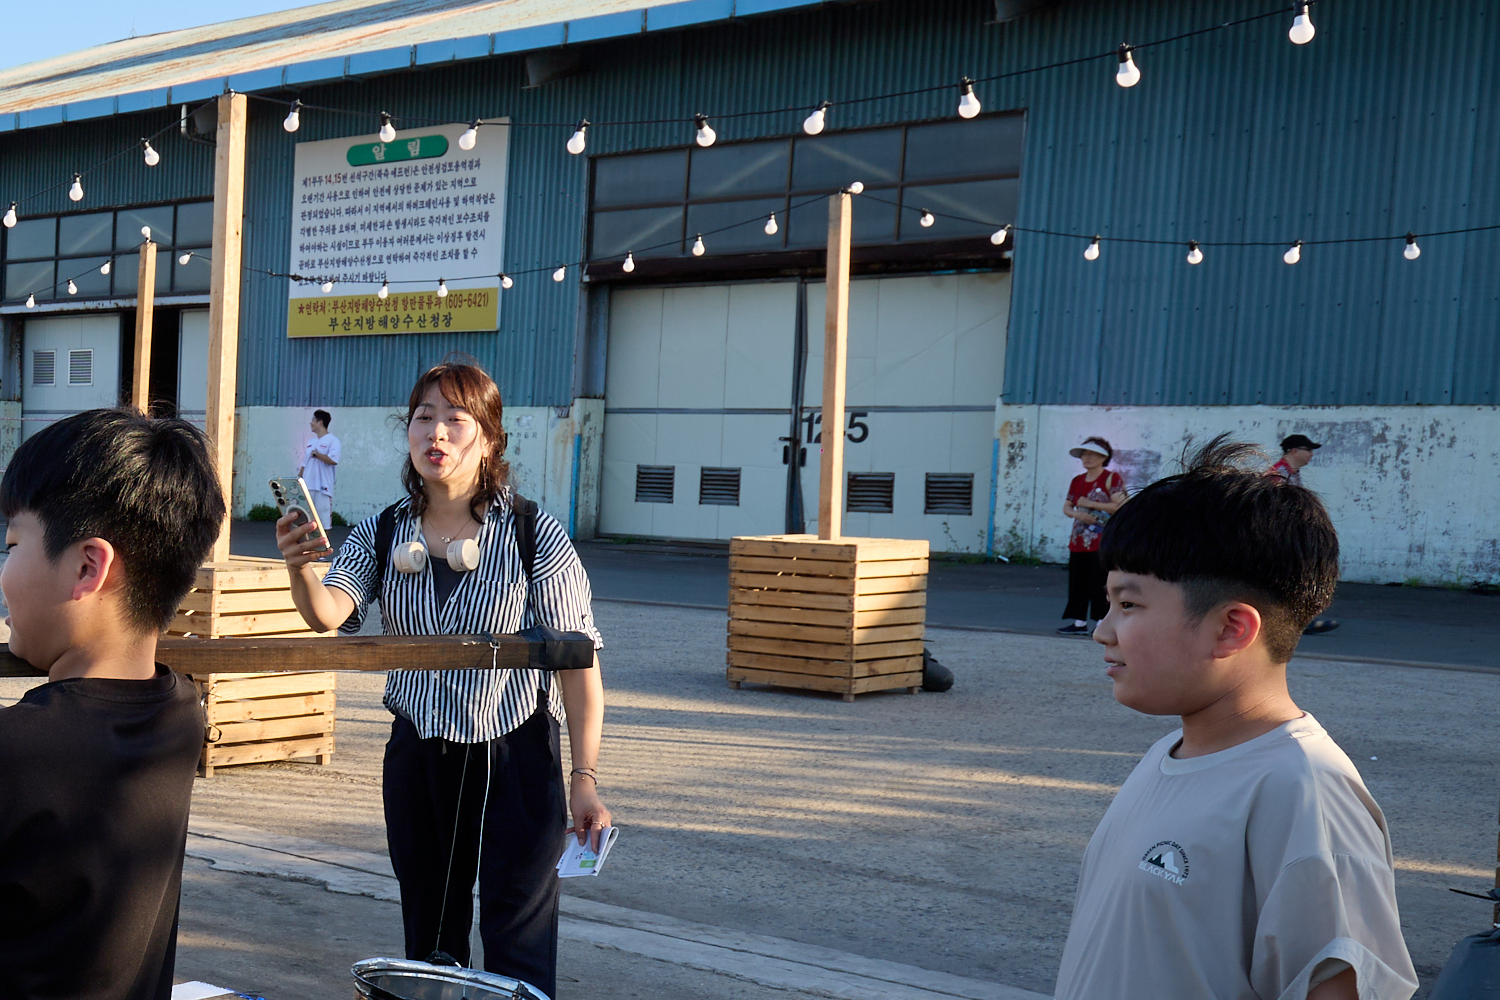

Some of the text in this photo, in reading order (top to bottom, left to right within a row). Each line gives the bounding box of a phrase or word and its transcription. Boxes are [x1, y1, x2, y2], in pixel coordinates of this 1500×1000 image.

[302, 175, 324, 188] 제1부두
[326, 190, 350, 202] 사용으로
[352, 187, 370, 199] 인하여
[372, 185, 391, 197] 안전에
[393, 183, 412, 195] 상당한
[414, 180, 433, 193] 문제가
[435, 179, 448, 191] 있는
[450, 177, 477, 190] 지역으로
[345, 204, 363, 216] 따라서
[364, 203, 371, 215] 이
[319, 224, 336, 236] 주의를
[471, 246, 478, 259] 수
[332, 296, 399, 314] 부산지방해양수산청
[445, 292, 489, 309] (609-6421)
[1171, 841, 1182, 850] DAY
[1179, 848, 1189, 864] SINCE
